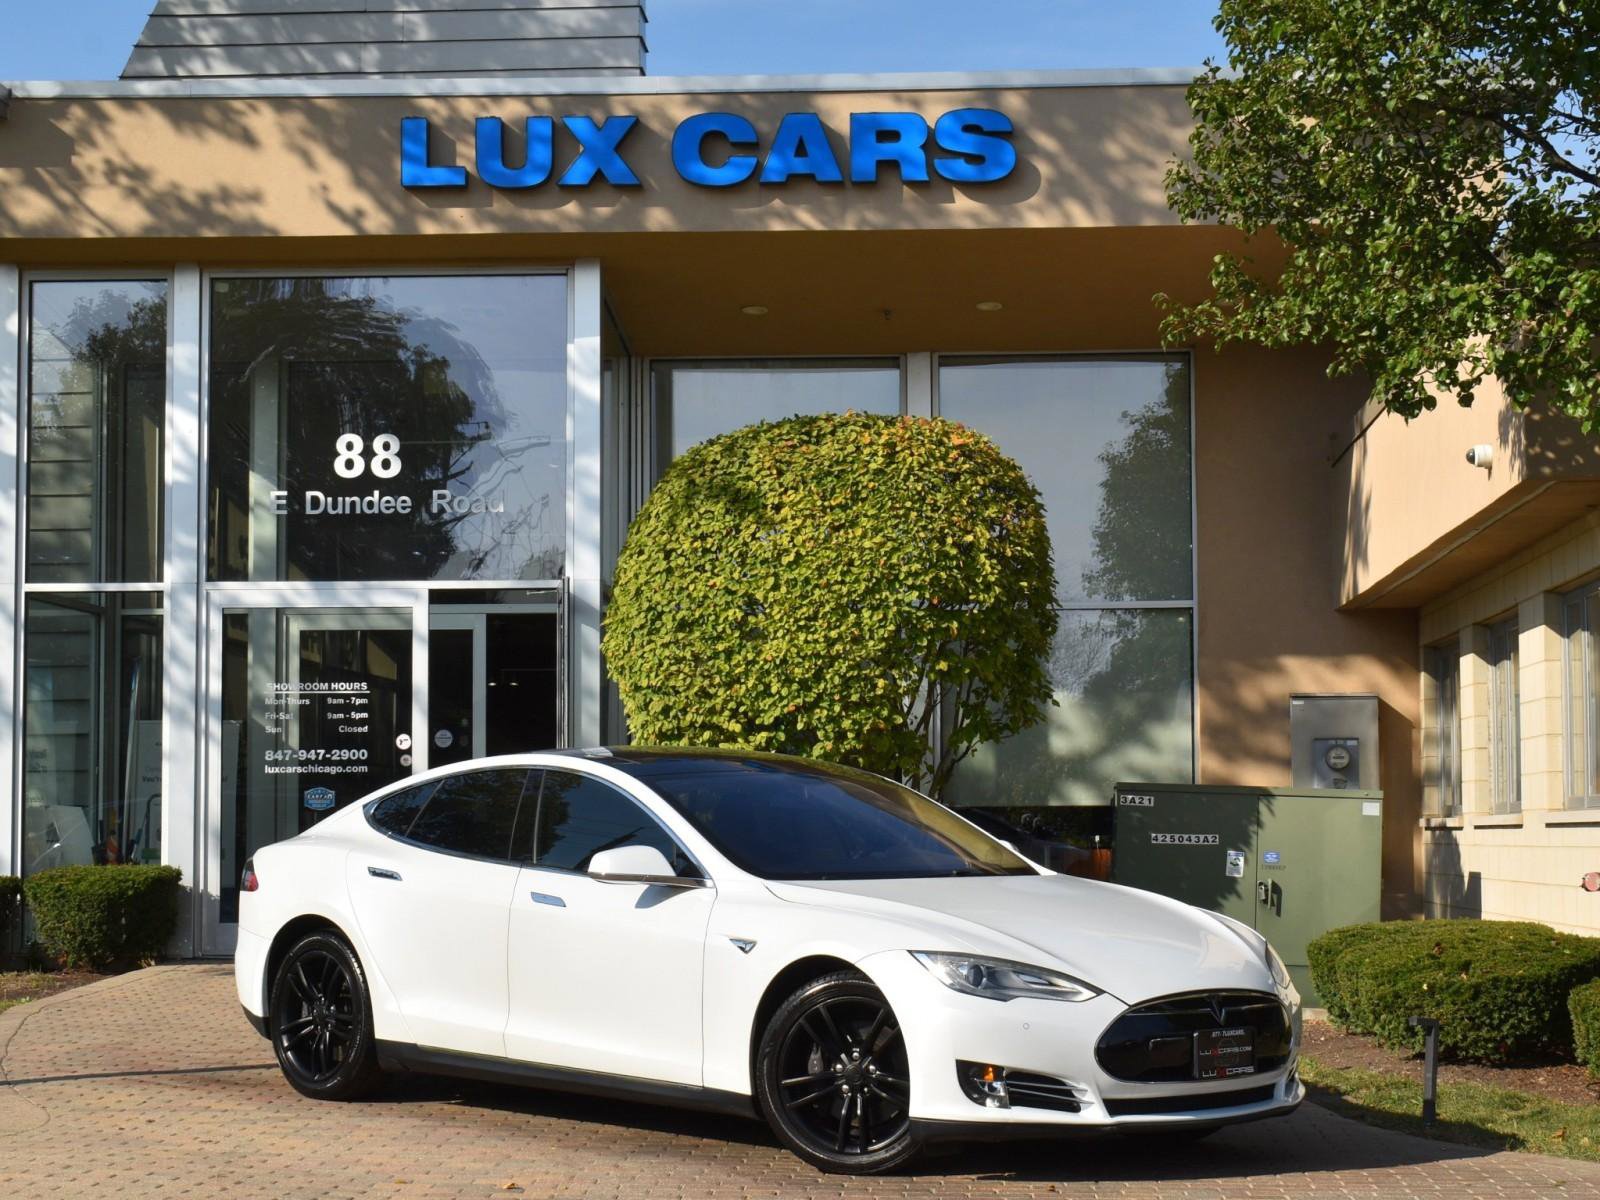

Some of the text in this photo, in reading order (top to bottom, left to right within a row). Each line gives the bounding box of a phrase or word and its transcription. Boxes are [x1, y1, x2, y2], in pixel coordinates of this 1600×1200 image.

[400, 108, 1017, 189] LUX CARS
[333, 433, 402, 479] 88
[269, 489, 504, 515] E Dundee Road
[266, 682, 368, 691] SHOWROOM HOURS
[327, 697, 345, 705] 9am
[350, 697, 368, 706] 7pm
[327, 712, 345, 720] 9am
[350, 712, 368, 721] 5pm
[338, 725, 368, 733] Closed
[265, 749, 368, 761] 847-947-2900
[265, 764, 368, 775] luxcarschicago.com
[1121, 796, 1153, 806] 3A21
[1151, 834, 1218, 844] 425043A2
